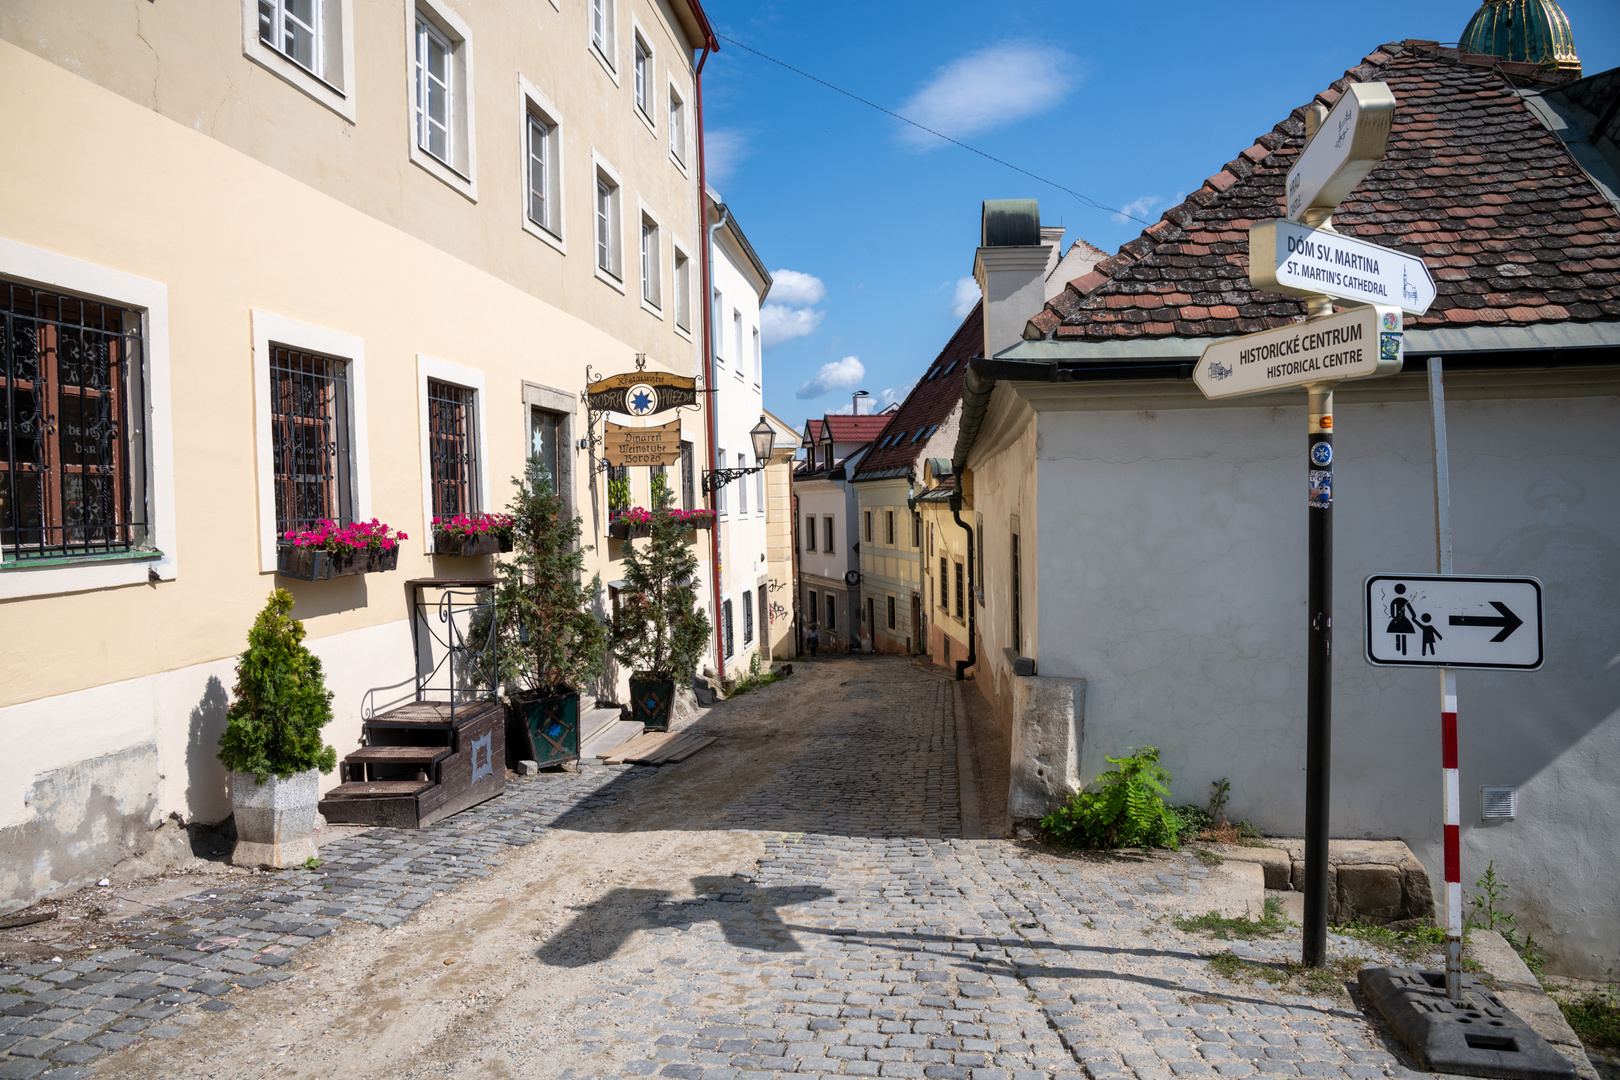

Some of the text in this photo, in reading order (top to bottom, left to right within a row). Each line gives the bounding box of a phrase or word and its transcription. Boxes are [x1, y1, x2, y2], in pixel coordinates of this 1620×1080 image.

[1288, 235, 1380, 275] DÓM SV. MARTINA
[1287, 261, 1388, 297] ST. MARTIN'S CATHEDRAL
[1239, 334, 1300, 365] HISTORICKÉ
[1302, 323, 1363, 352] CENTRUM
[1267, 349, 1363, 379] HISTORICAL CENTRE
[616, 376, 664, 386] Restaurant
[619, 444, 667, 454] Weinstube
